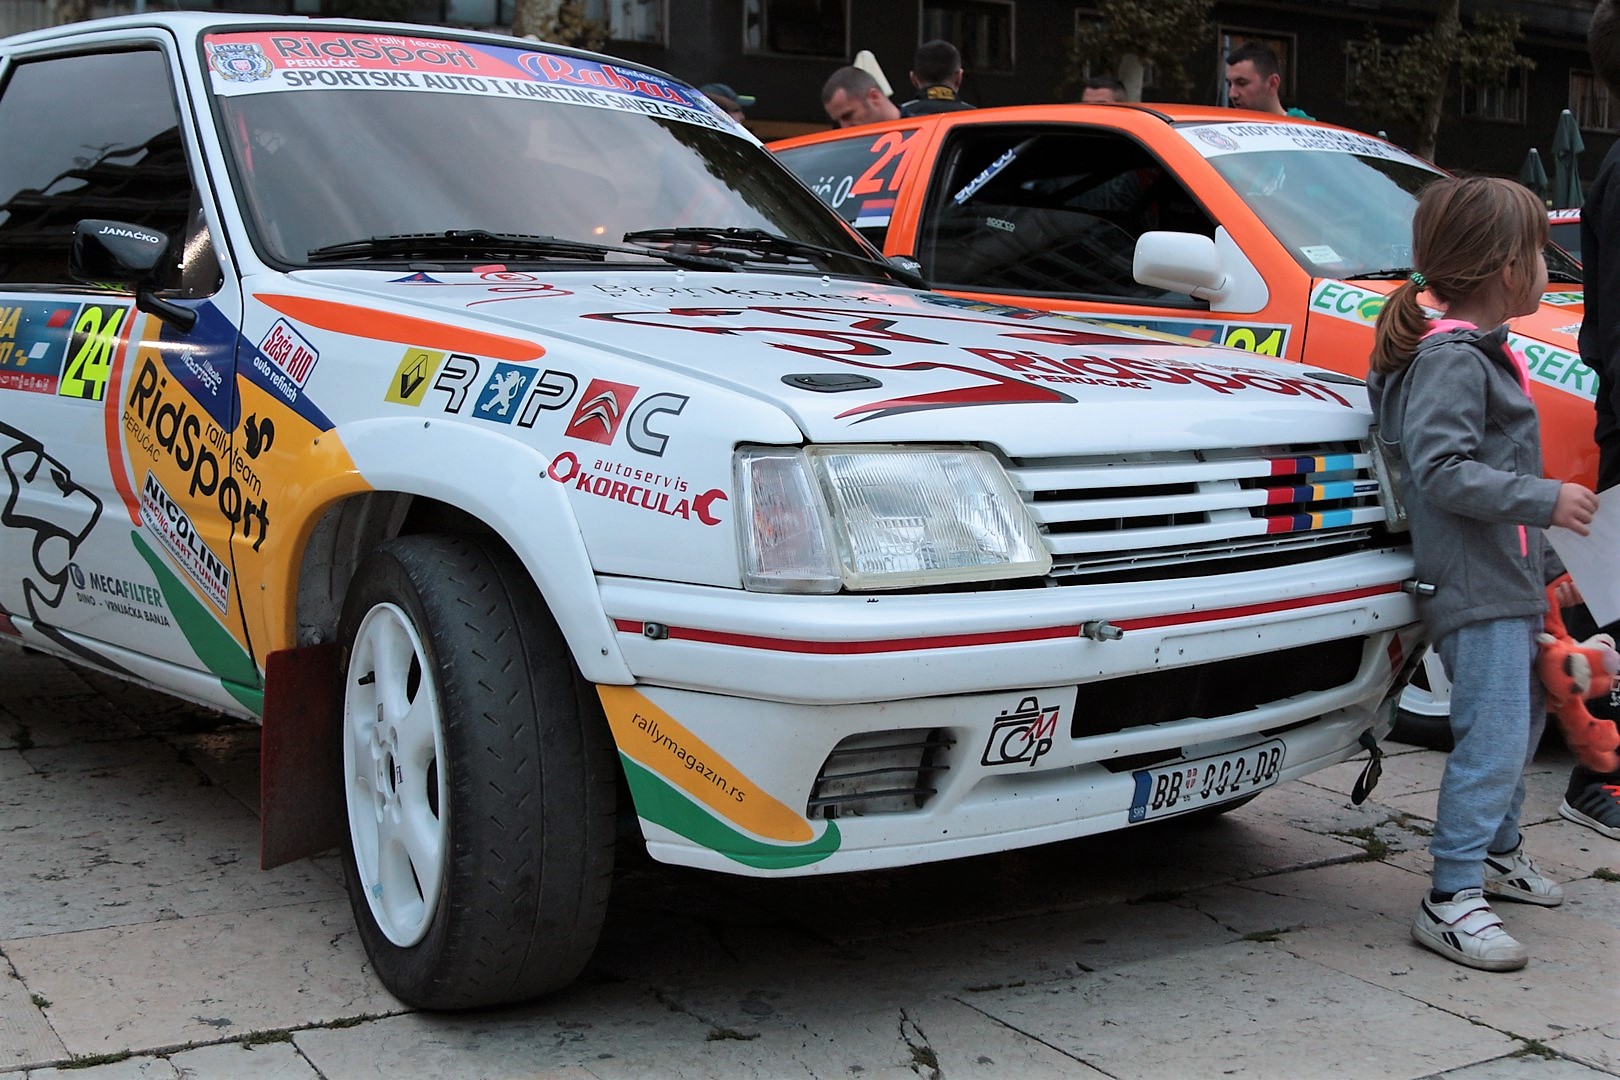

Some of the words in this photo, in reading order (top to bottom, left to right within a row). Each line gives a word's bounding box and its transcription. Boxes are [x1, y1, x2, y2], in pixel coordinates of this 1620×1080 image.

[373, 37, 405, 47] rally
[409, 39, 451, 50] team
[282, 70, 420, 88] SPORTSKI
[421, 73, 486, 94] AUTO
[493, 79, 508, 95] I
[508, 81, 608, 108] KARTING
[605, 94, 667, 116] SAVEZ
[851, 127, 925, 195] 21
[59, 306, 125, 400] 24
[286, 345, 313, 383] RID
[253, 356, 271, 376] auto
[269, 371, 297, 403] refinish
[434, 353, 480, 414] R
[517, 368, 578, 428] P
[625, 392, 690, 457] C
[204, 422, 233, 459] rally
[231, 447, 263, 497] team
[594, 459, 688, 493] autoservis
[576, 472, 690, 520] KORCULA
[143, 495, 168, 533] RACING
[169, 531, 192, 560] KART
[193, 558, 227, 600] TUNING
[145, 475, 229, 588] NICOLINI
[76, 591, 96, 606] DINO
[143, 610, 170, 627] BANJA
[90, 572, 163, 608] MECAFILTER
[631, 712, 746, 803] rallymagazin.rs
